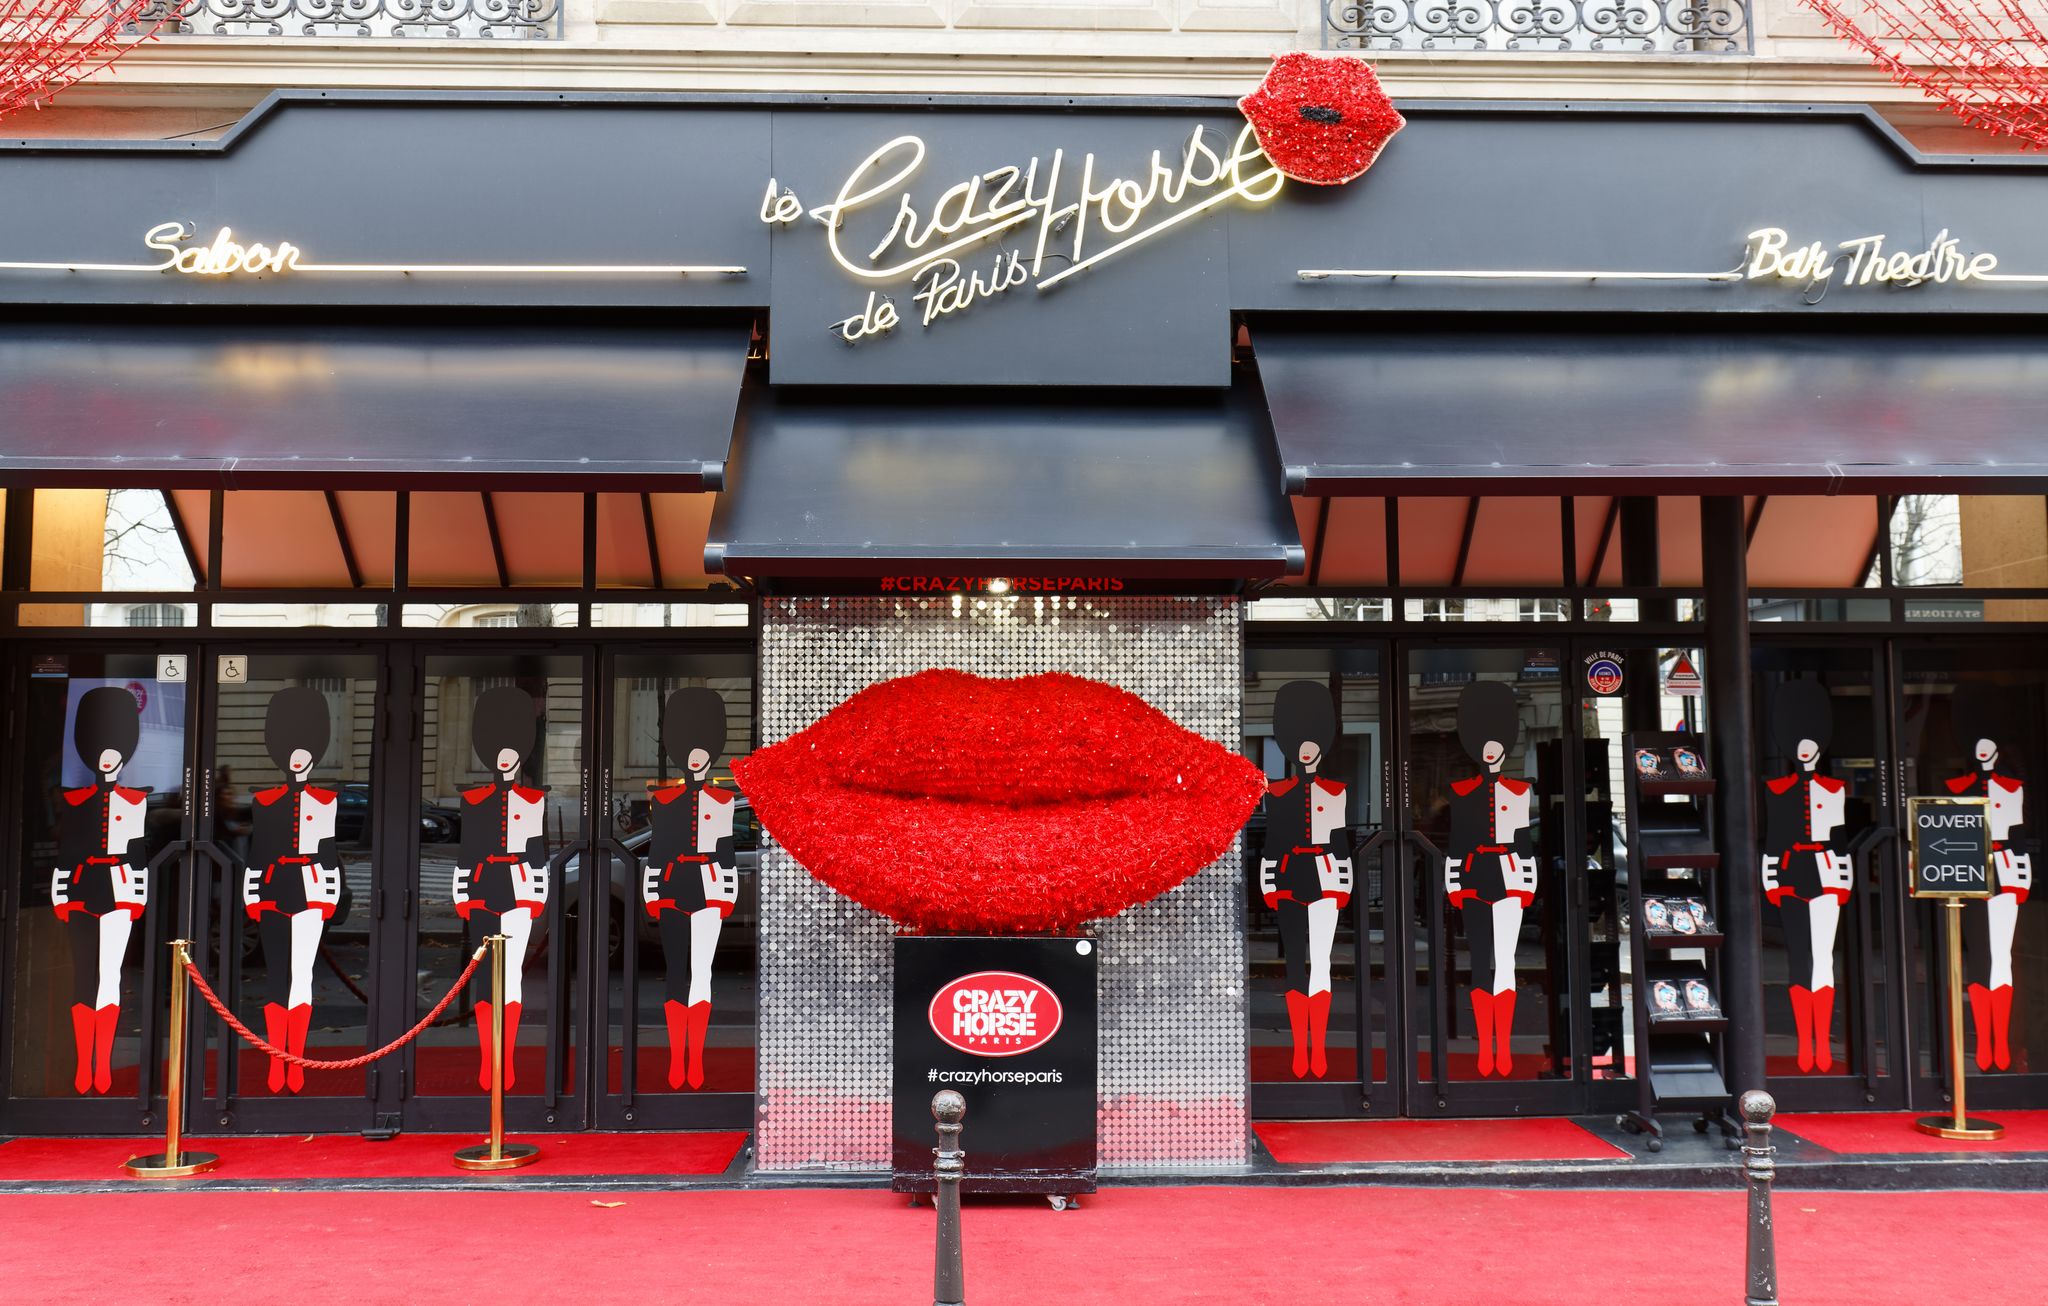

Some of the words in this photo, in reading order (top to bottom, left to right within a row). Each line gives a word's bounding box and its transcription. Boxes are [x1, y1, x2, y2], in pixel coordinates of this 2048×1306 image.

[760, 178, 803, 223] le
[809, 136, 1064, 278] Crazy
[1034, 123, 1285, 278] Horse
[145, 221, 300, 275] Saloon
[1747, 228, 1833, 280] Bar
[1838, 228, 1998, 285] Theatre
[842, 291, 900, 340] de
[913, 249, 1028, 327] Paris
[1584, 652, 1599, 665] VILLE
[1607, 651, 1625, 664] PARIS
[1918, 814, 1985, 828] OUVERT
[1922, 864, 1985, 882] OPEN
[952, 989, 1039, 1013] CRAZY
[953, 1012, 1036, 1036] HORSE
[968, 1037, 1022, 1045] PARIS
[927, 1068, 1063, 1086] #crazyhorseparis
